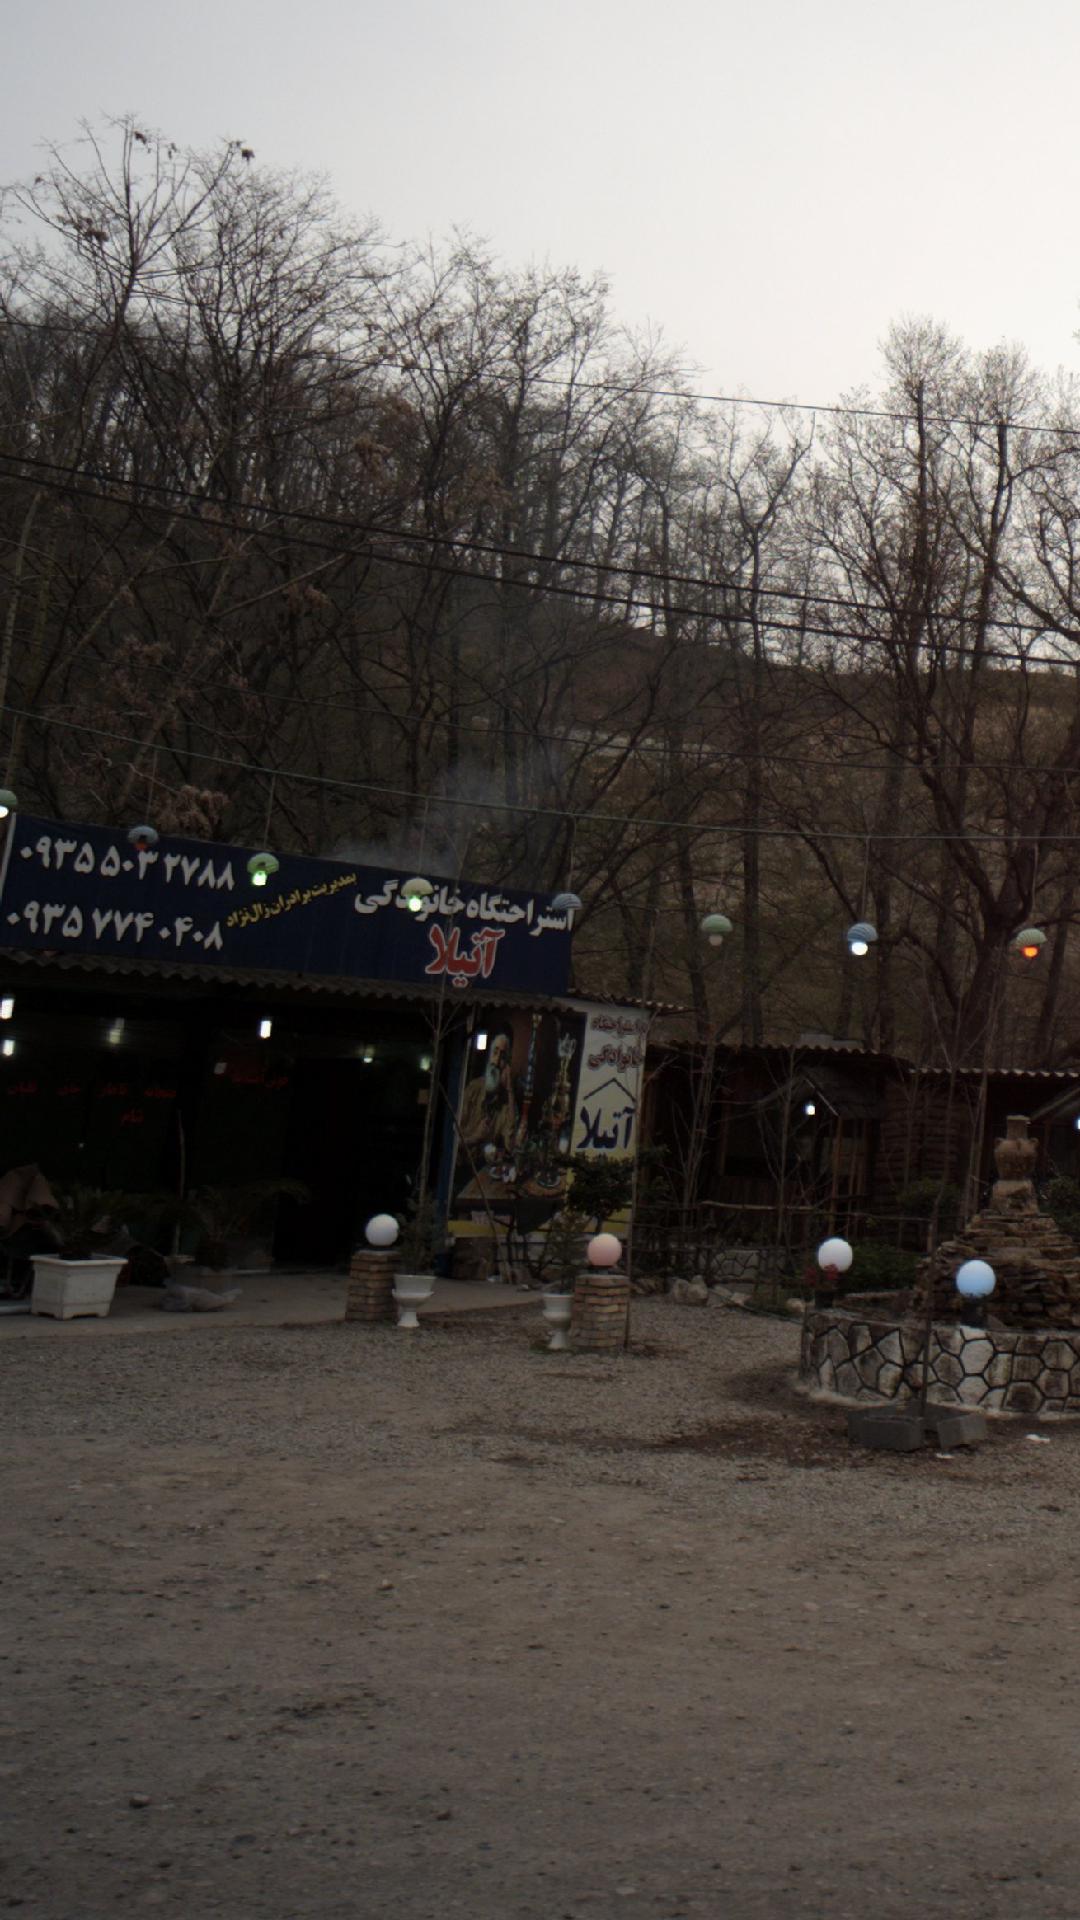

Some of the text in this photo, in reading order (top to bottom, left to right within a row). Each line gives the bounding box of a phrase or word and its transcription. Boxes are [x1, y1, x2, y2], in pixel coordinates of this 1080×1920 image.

[20, 835, 95, 874] ۰۹۳۵
[100, 845, 159, 880] ۵۰۳
[354, 879, 466, 922] خانودگی
[6, 900, 224, 951] ۰۹۳۵ ۷۷۴ ۰۴۰۸
[425, 923, 506, 988] آتیلا
[576, 1105, 636, 1149] آتیلا
